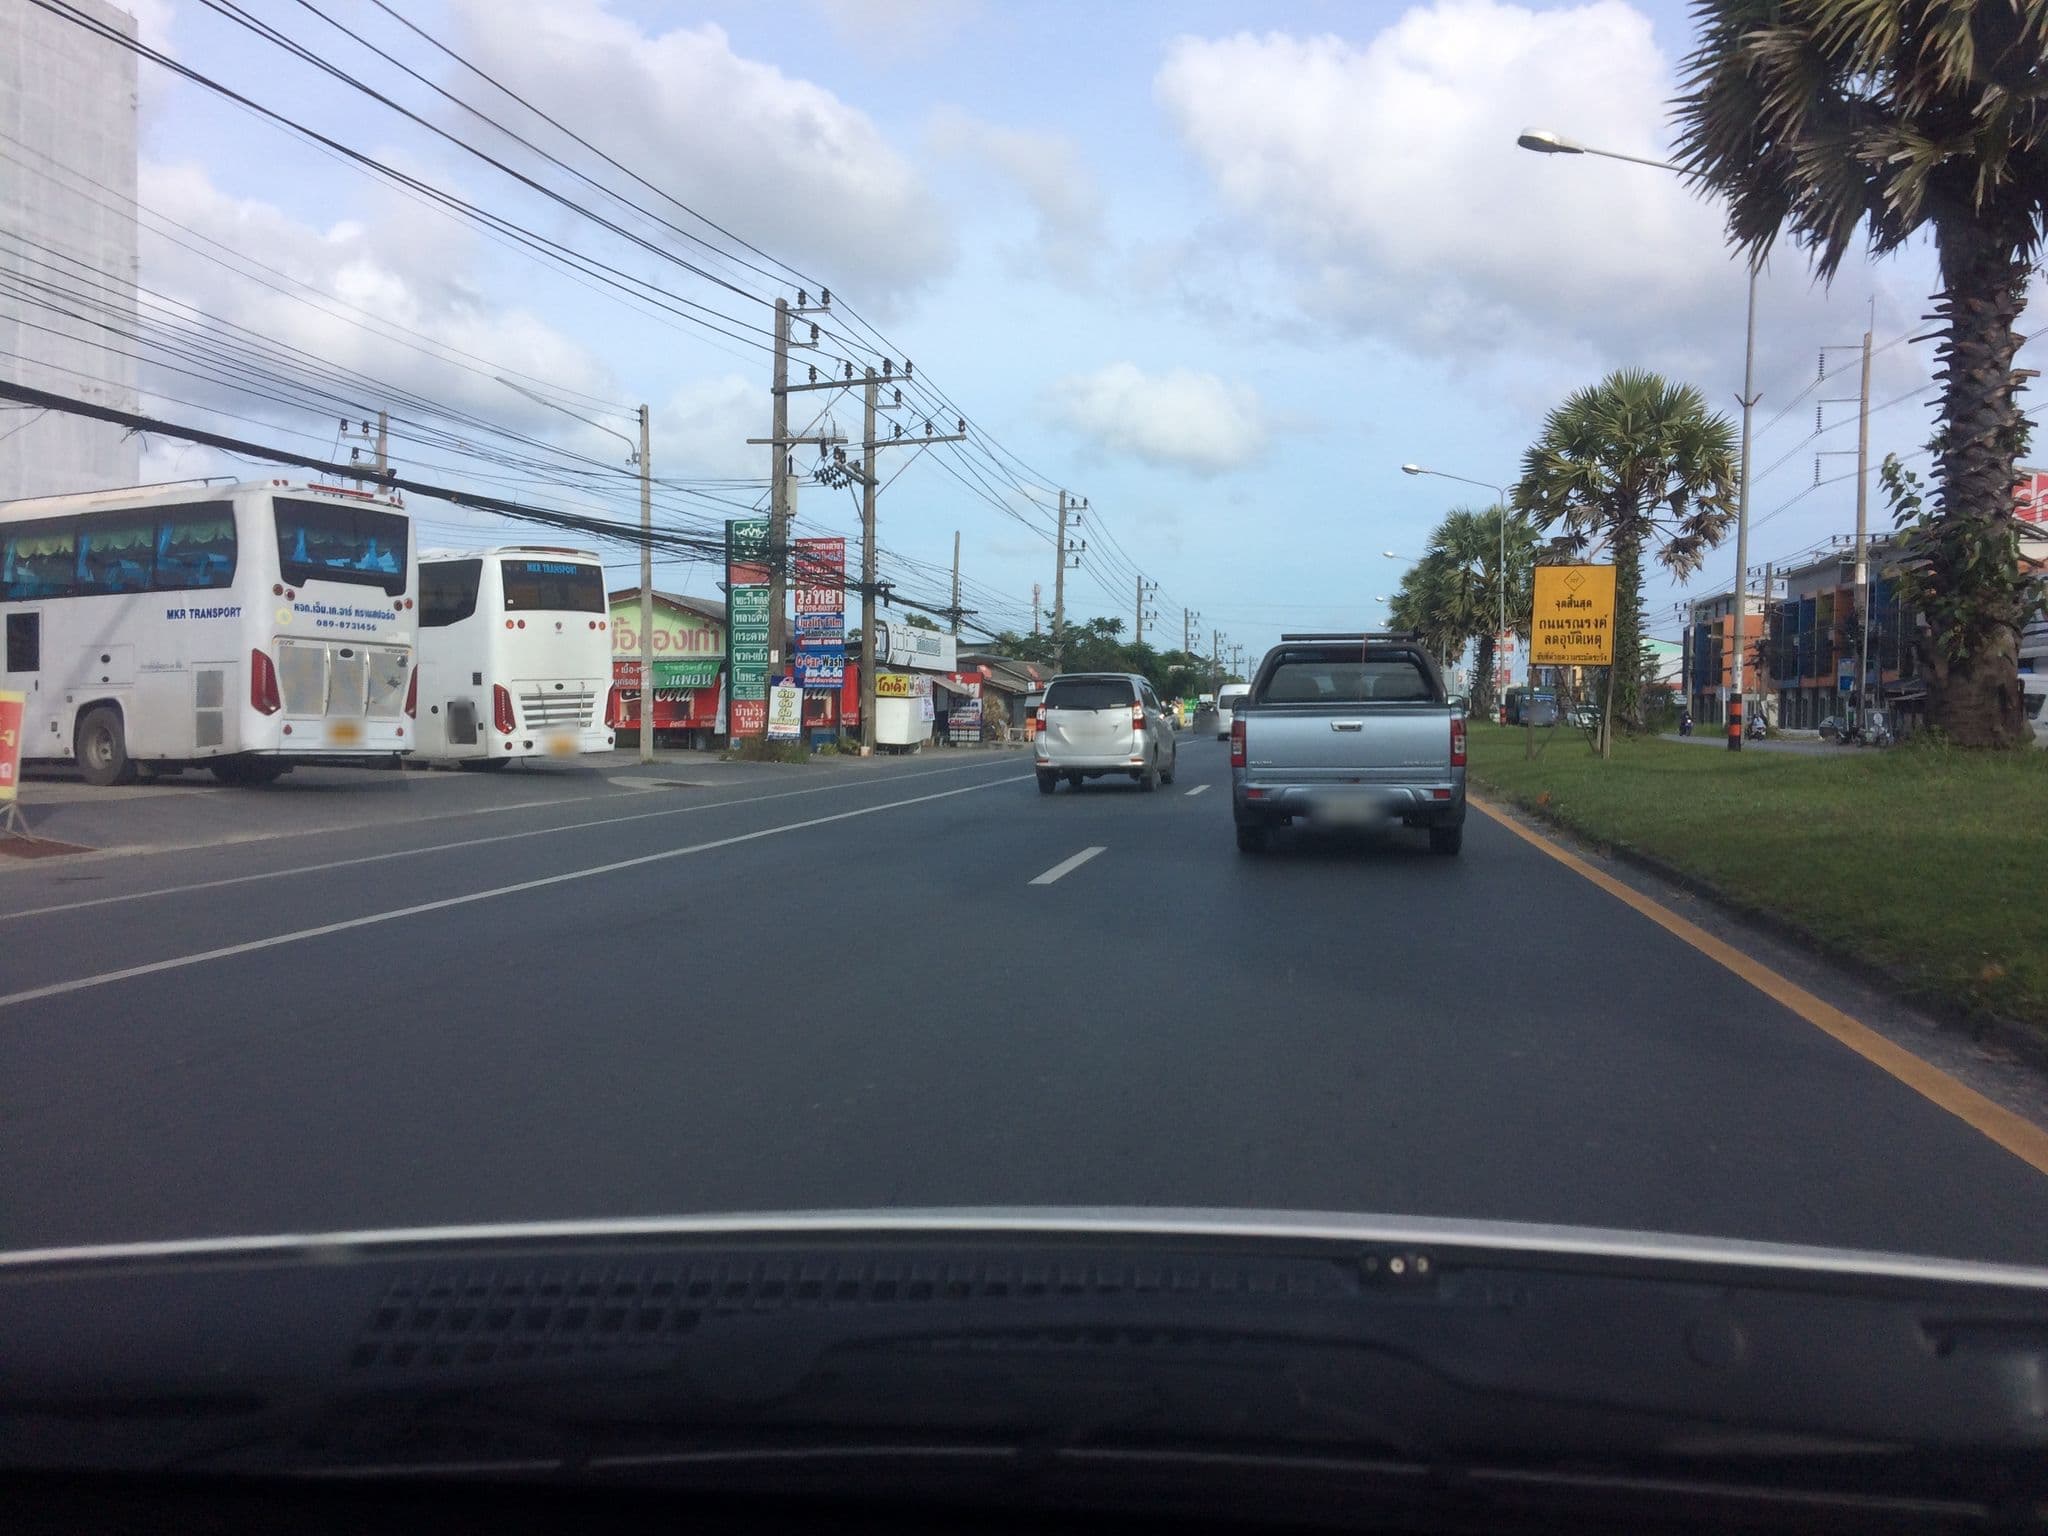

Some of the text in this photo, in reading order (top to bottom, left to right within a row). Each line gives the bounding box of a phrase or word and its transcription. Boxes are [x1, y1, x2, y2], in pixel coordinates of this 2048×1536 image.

[543, 563, 577, 575] TRANSPORT
[1555, 594, 1592, 612] จุดสิ้นสุด
[166, 607, 242, 620] MKR TRANSPORT
[825, 616, 843, 628] Film
[1539, 614, 1608, 630] ถนนรณรงค์
[1544, 630, 1602, 649] ลดอุบัติเหตุ
